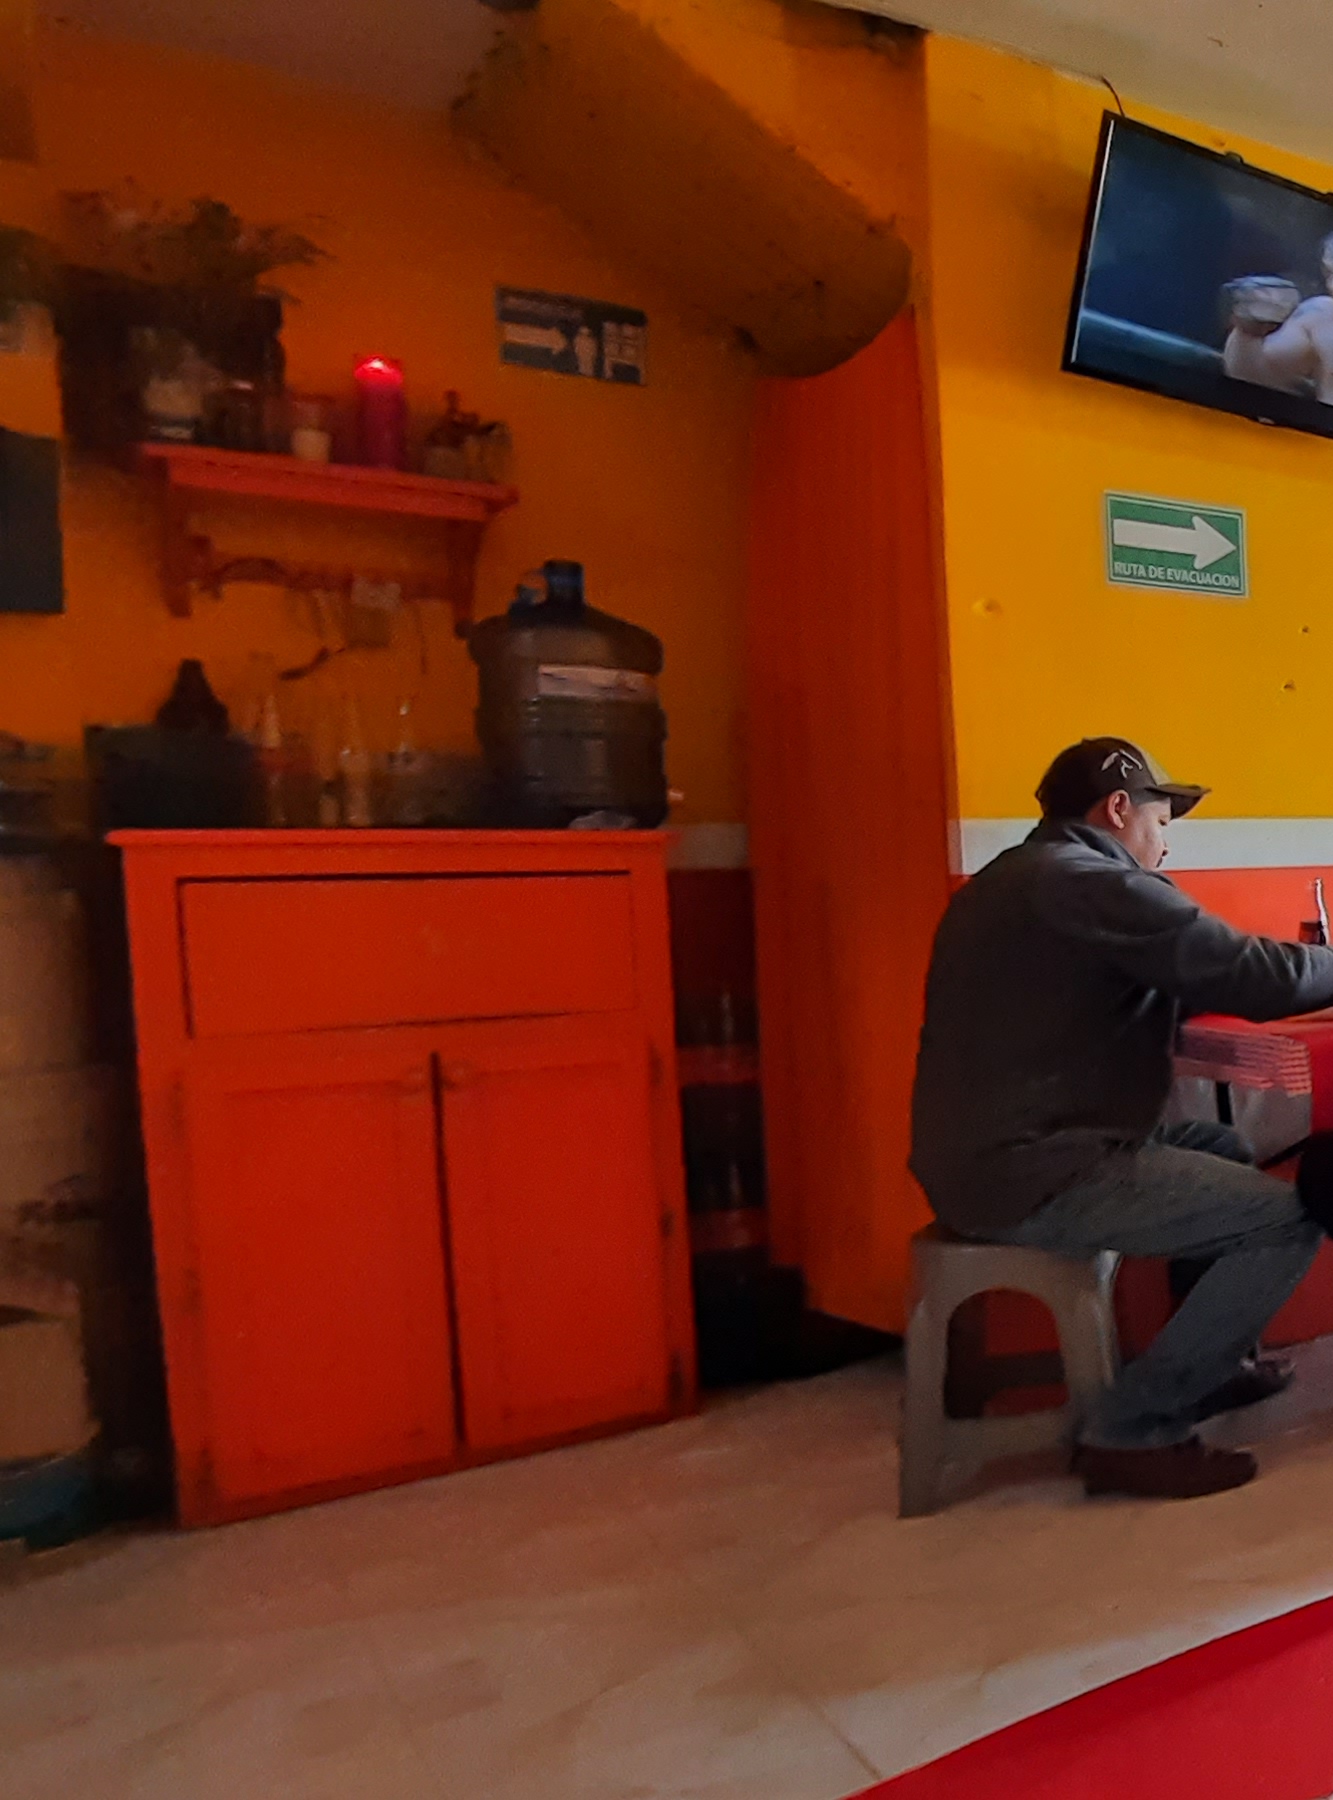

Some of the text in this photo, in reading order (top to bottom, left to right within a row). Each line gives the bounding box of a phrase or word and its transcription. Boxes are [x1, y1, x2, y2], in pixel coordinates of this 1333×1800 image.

[1113, 562, 1239, 588] RUTA DE EVACUACION
